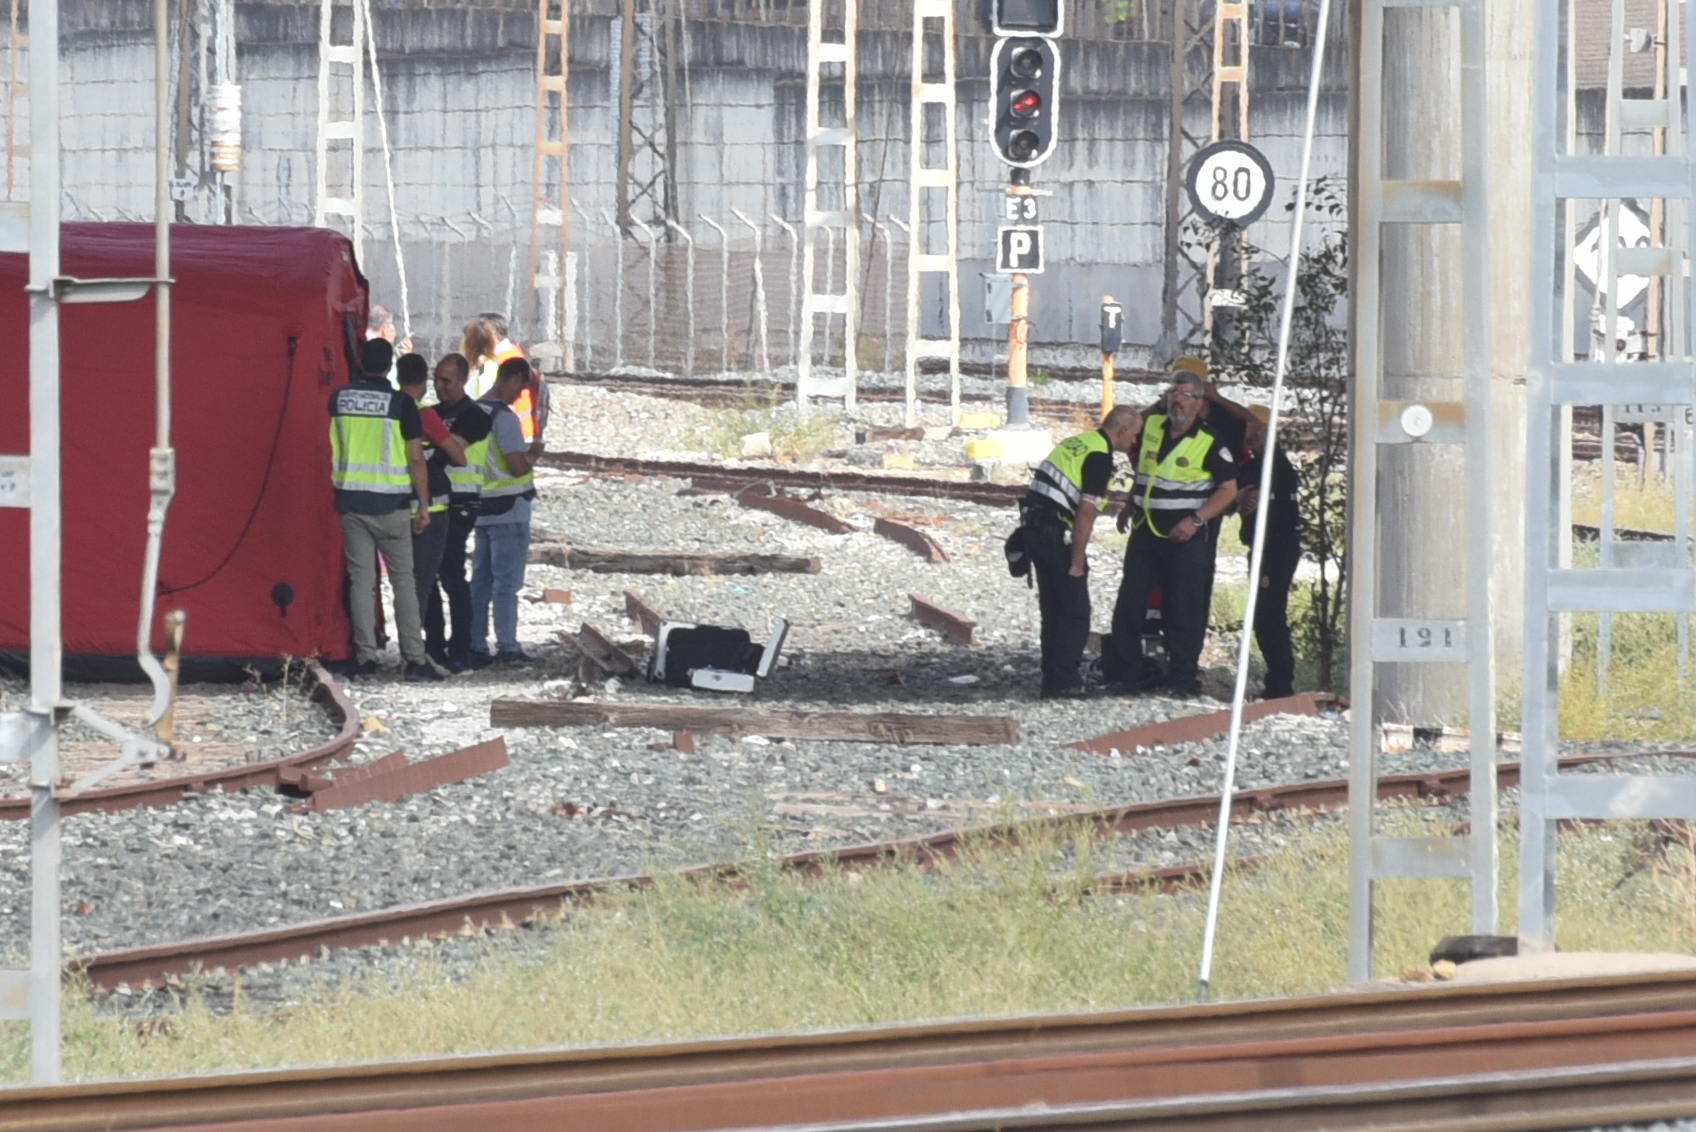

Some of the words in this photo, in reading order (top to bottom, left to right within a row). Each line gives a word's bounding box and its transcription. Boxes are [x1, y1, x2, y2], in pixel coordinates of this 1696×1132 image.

[1212, 166, 1251, 202] 80
[1006, 197, 1037, 220] E3
[1010, 232, 1032, 268] P
[1103, 306, 1122, 329] T
[340, 399, 386, 413] POLICIA
